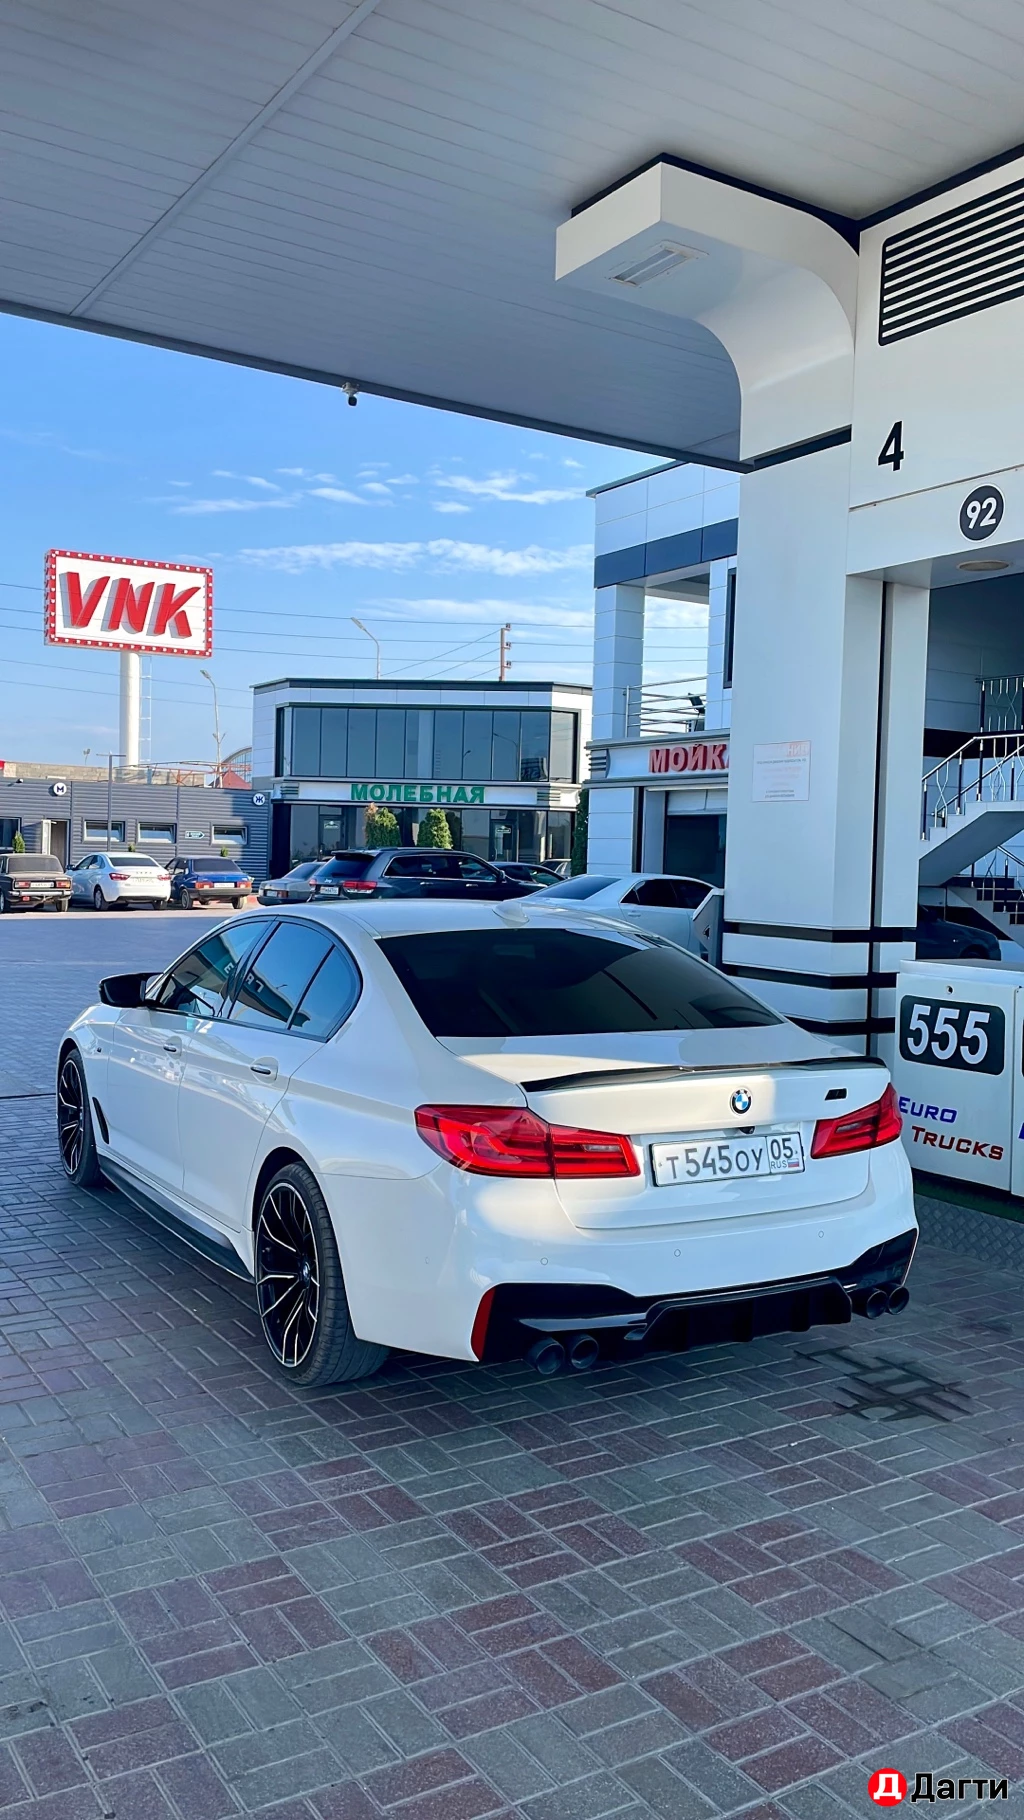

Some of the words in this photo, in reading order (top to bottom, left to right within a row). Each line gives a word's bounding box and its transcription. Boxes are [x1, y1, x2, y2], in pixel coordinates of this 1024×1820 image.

[877, 420, 905, 471] 4
[966, 496, 998, 530] 92
[59, 571, 201, 640] VNK
[649, 743, 730, 773] МОЙК
[56, 783, 66, 794] М
[255, 795, 264, 804] Ж
[350, 783, 486, 804] МОЛЕБНАЯ
[907, 1003, 991, 1064] 555
[898, 1097, 957, 1124] EURO
[770, 1137, 794, 1160] 05
[911, 1125, 1004, 1161] TRUCKS
[770, 1159, 788, 1170] RUS
